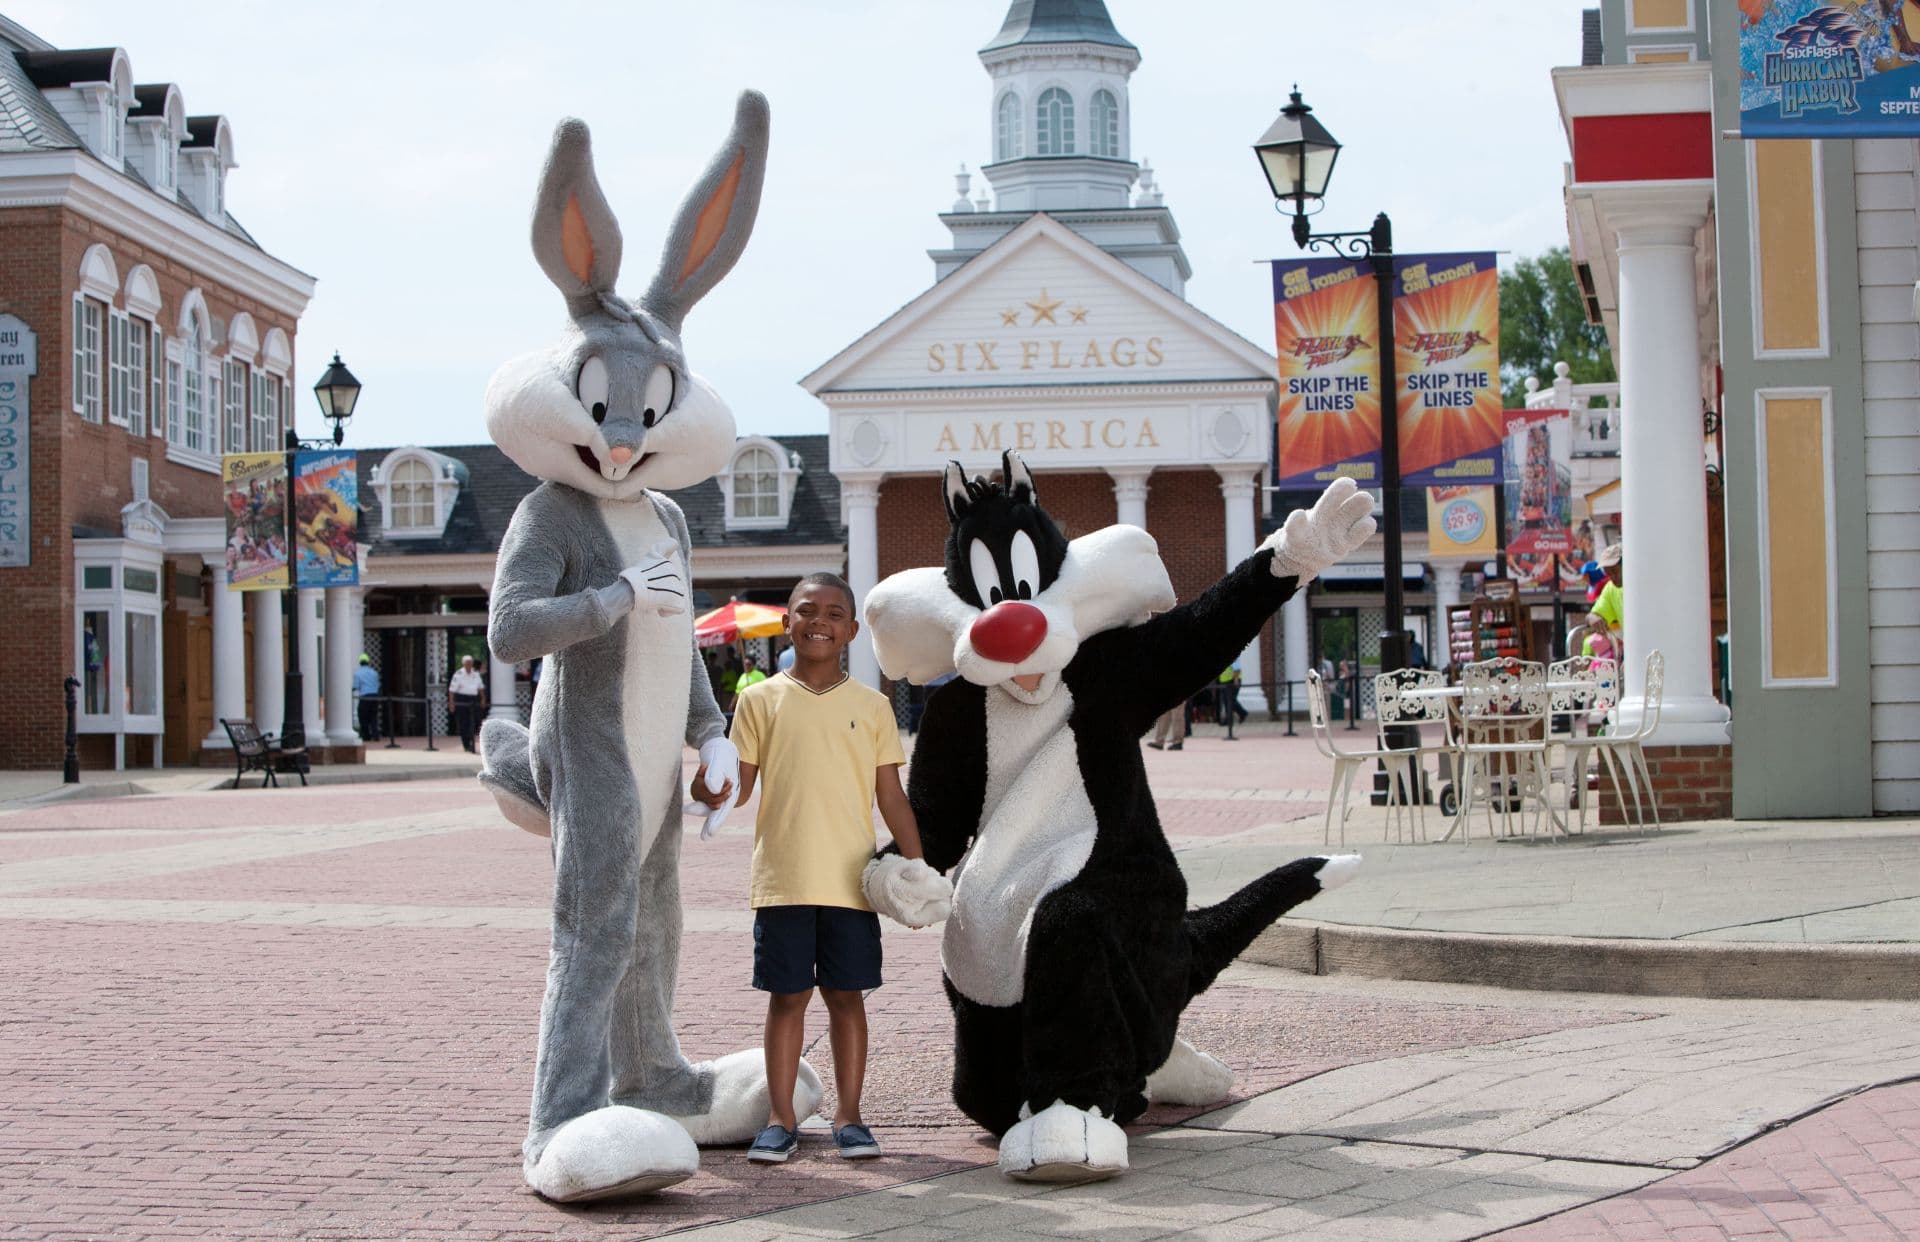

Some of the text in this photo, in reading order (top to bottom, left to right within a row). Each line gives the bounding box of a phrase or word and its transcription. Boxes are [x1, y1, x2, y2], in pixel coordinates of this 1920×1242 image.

[1768, 52, 1860, 84] HURRICANE
[1785, 81, 1853, 113] HARBOR
[1311, 266, 1358, 290] TODAY!
[1430, 261, 1477, 285] TODAY!
[927, 336, 1165, 373] SIX FLAGS
[1289, 375, 1369, 394] SKIP THE
[1407, 371, 1488, 390] SKIP THE
[1305, 394, 1355, 411] LINES
[1423, 390, 1474, 407] LINES
[935, 416, 1160, 452] AMERICA
